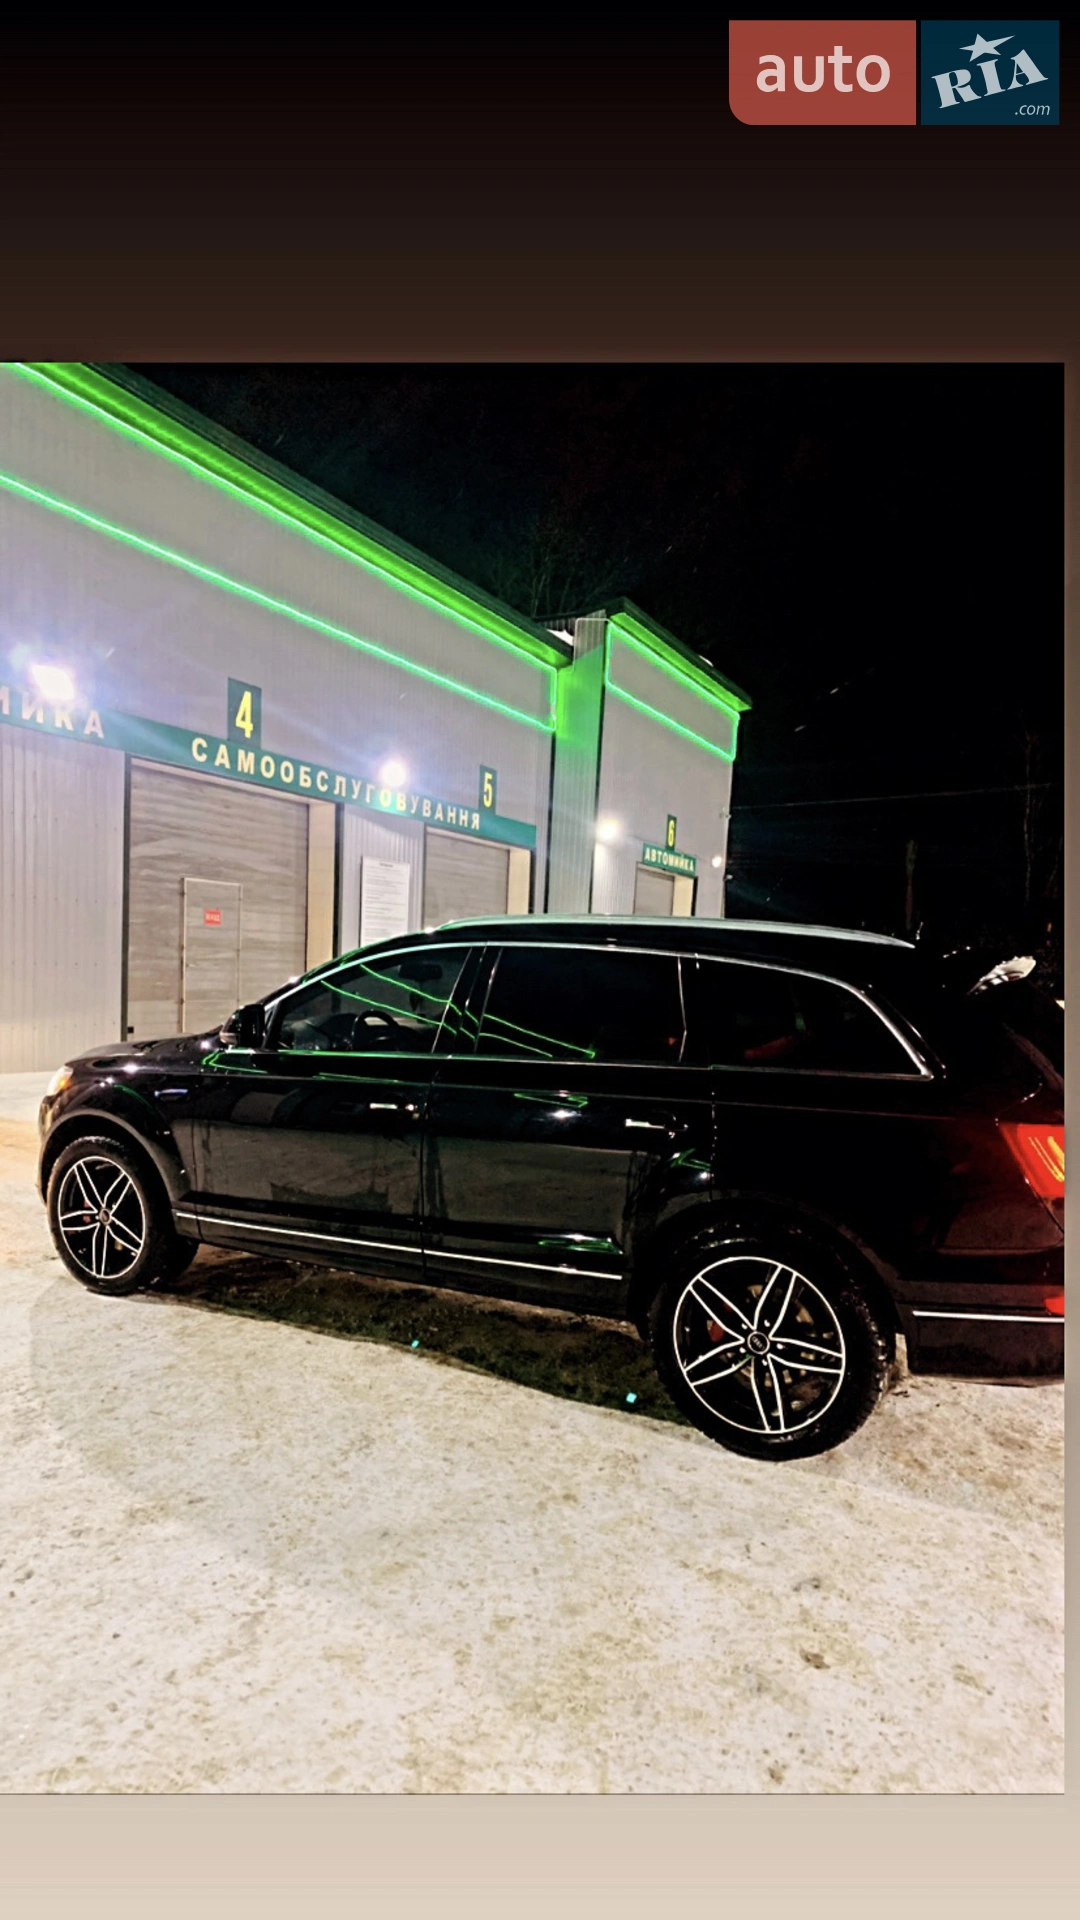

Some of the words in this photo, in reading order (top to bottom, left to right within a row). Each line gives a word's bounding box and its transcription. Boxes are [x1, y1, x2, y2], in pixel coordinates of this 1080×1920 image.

[235, 690, 254, 739] 4
[191, 737, 481, 831] САМООБСЛУГОВУВАННЯ
[483, 771, 493, 808] 5
[667, 819, 675, 847] 6
[644, 847, 695, 872] АВТОМИЙКА
